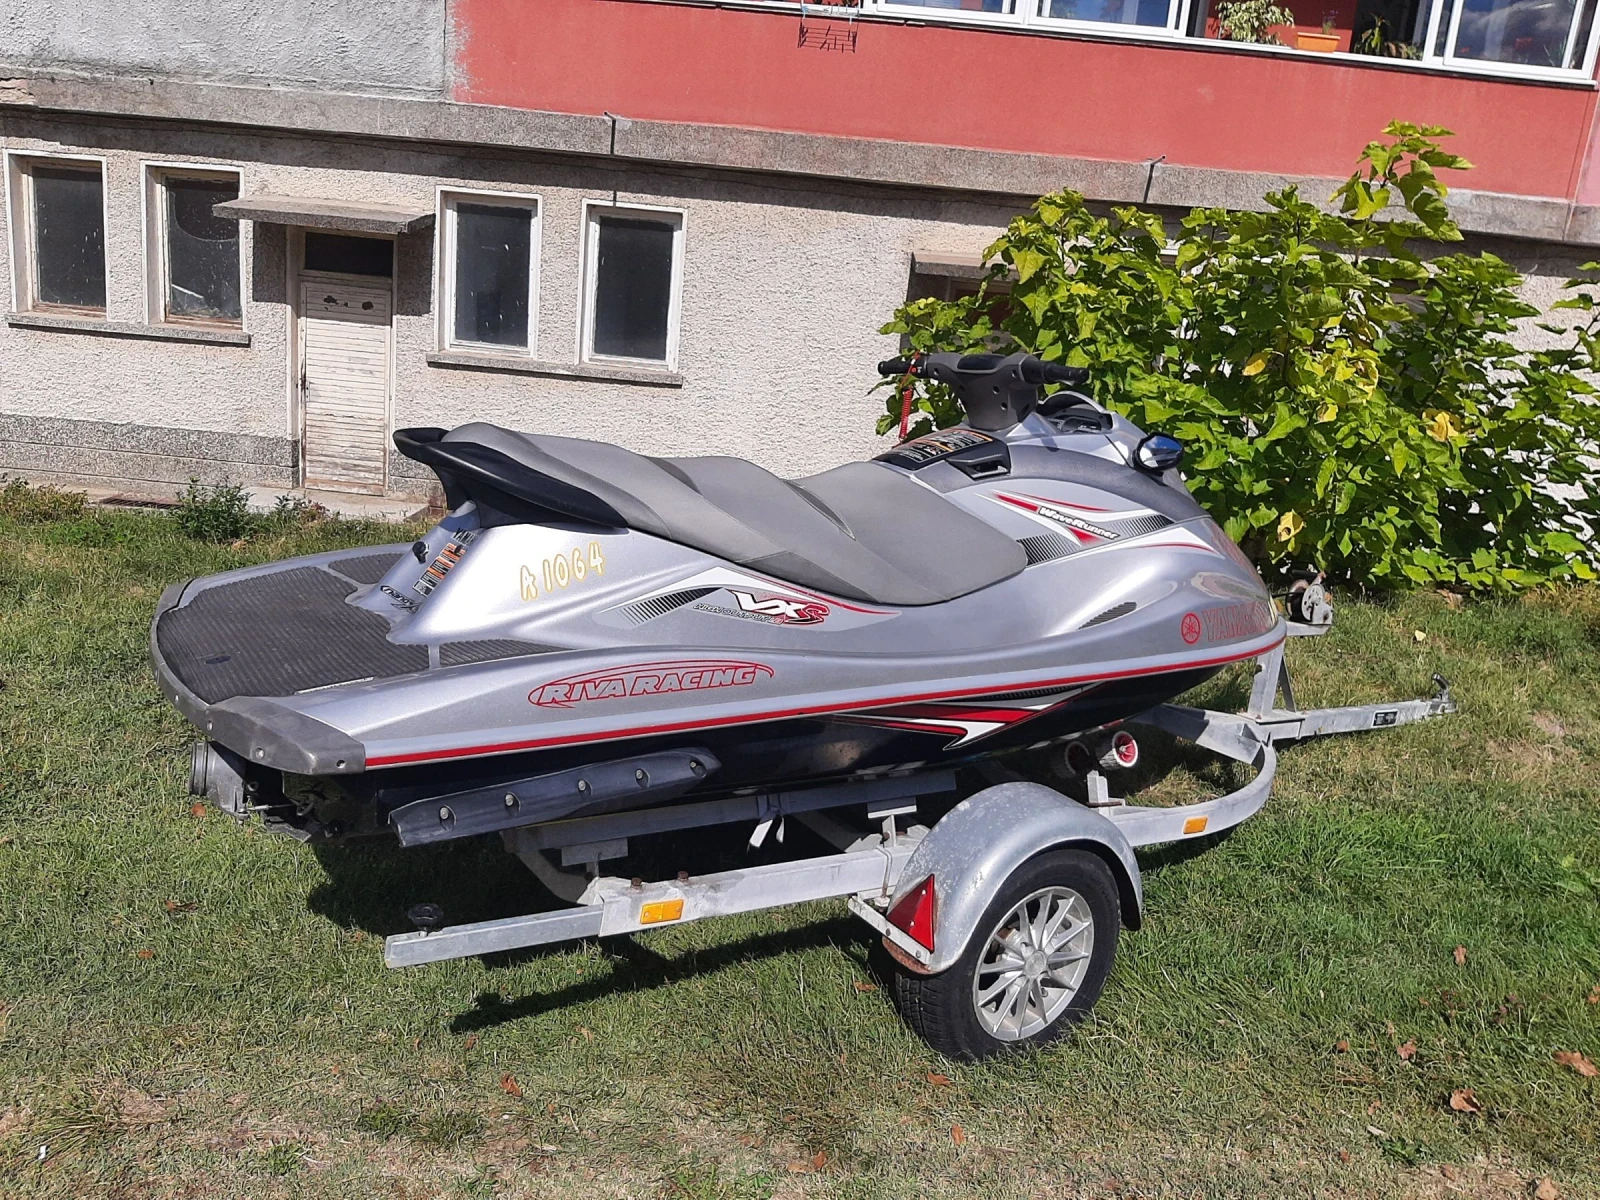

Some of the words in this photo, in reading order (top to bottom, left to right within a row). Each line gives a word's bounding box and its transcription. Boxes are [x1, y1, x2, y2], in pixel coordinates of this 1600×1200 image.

[1038, 505, 1120, 540] WaveRunner
[536, 678, 628, 705] RIVA
[629, 665, 758, 696] RACING
